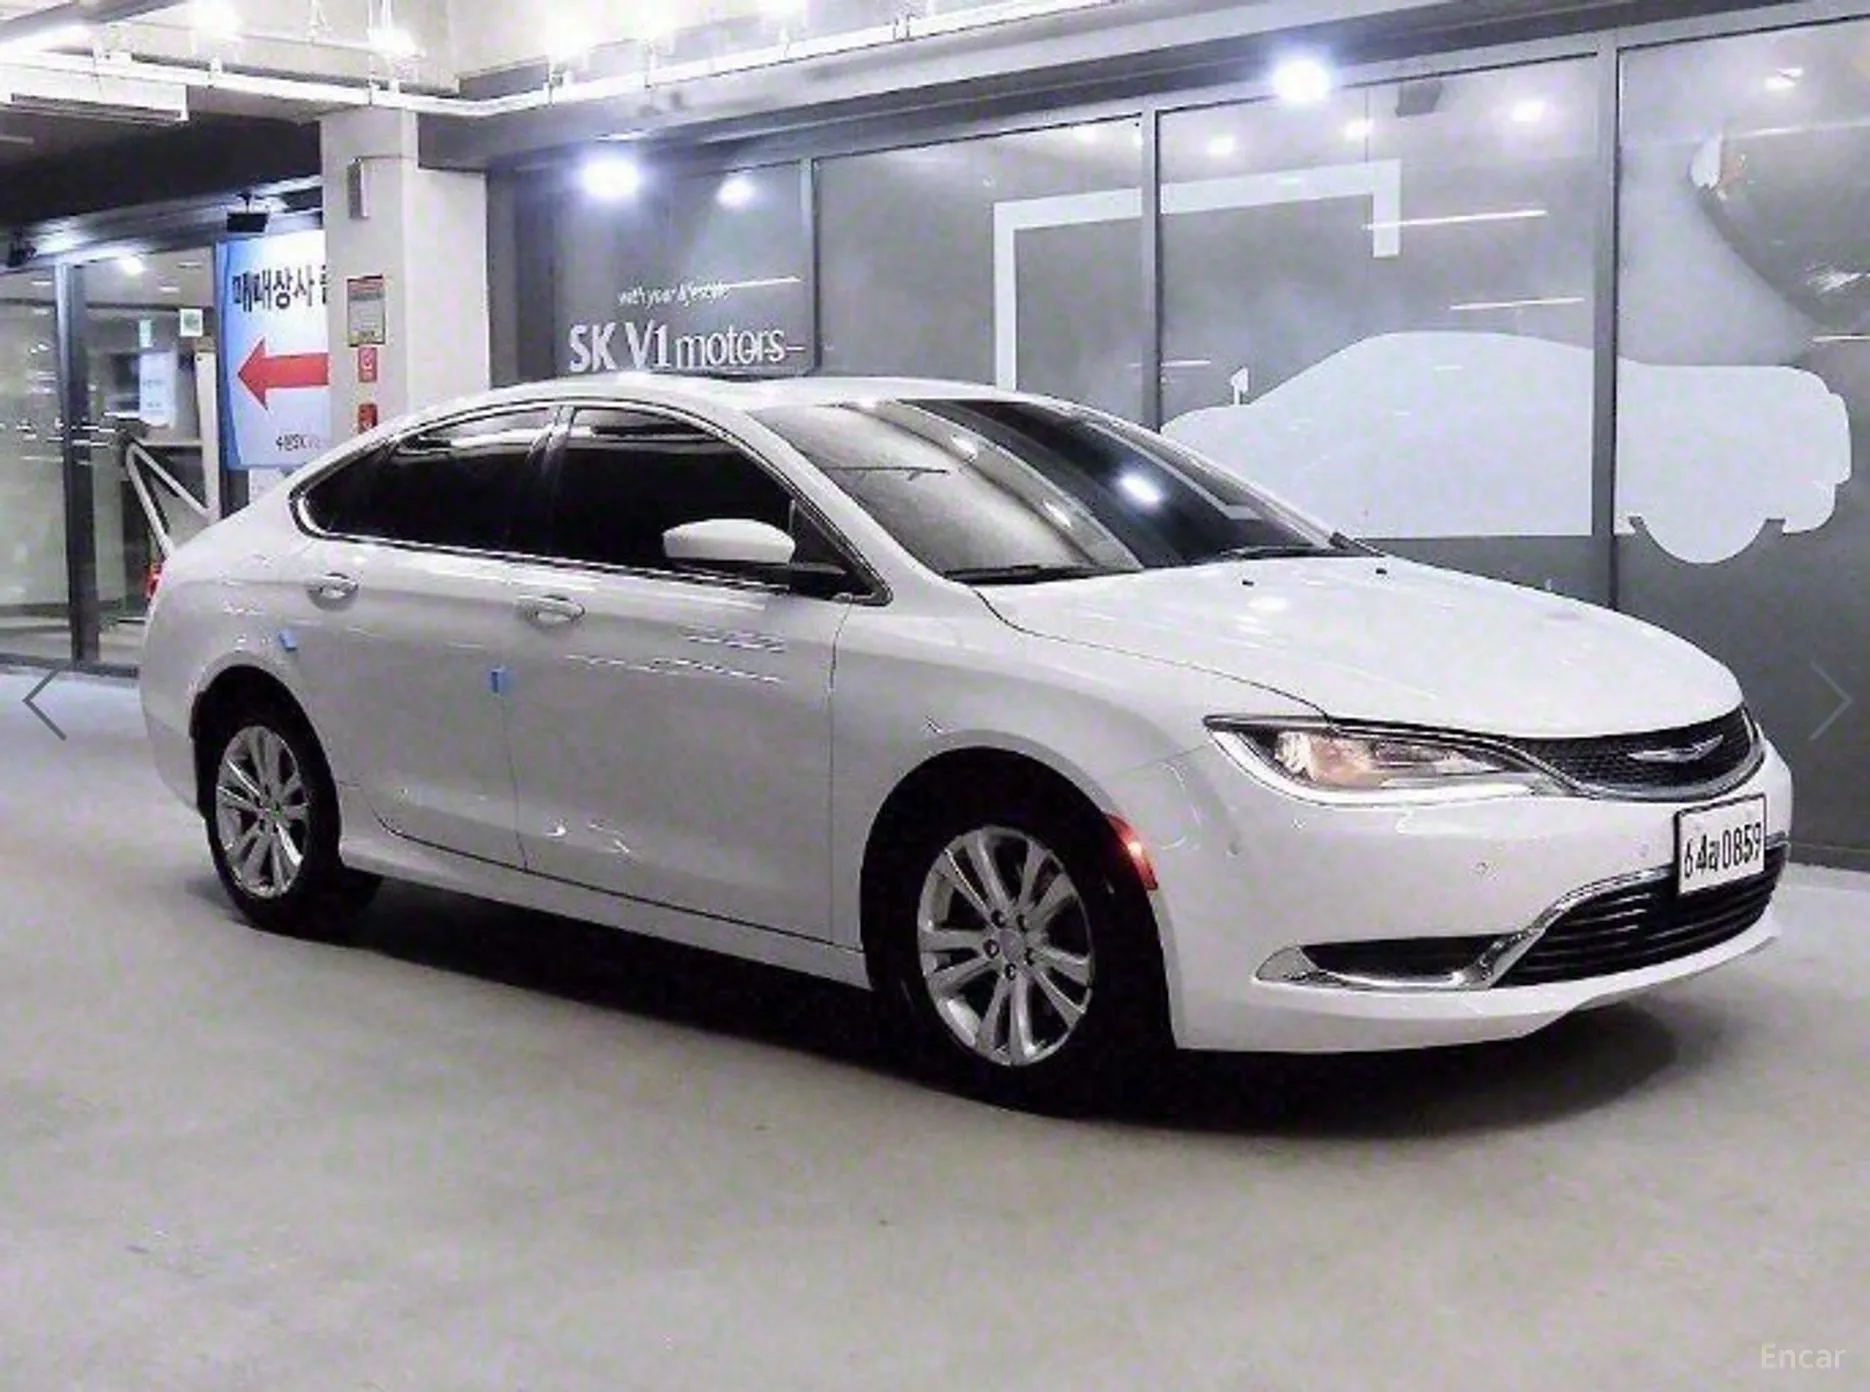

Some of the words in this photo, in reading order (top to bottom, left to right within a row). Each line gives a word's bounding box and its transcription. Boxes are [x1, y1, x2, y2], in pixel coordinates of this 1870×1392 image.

[569, 321, 617, 373] SK
[624, 319, 671, 371] V1
[675, 325, 785, 371] motors
